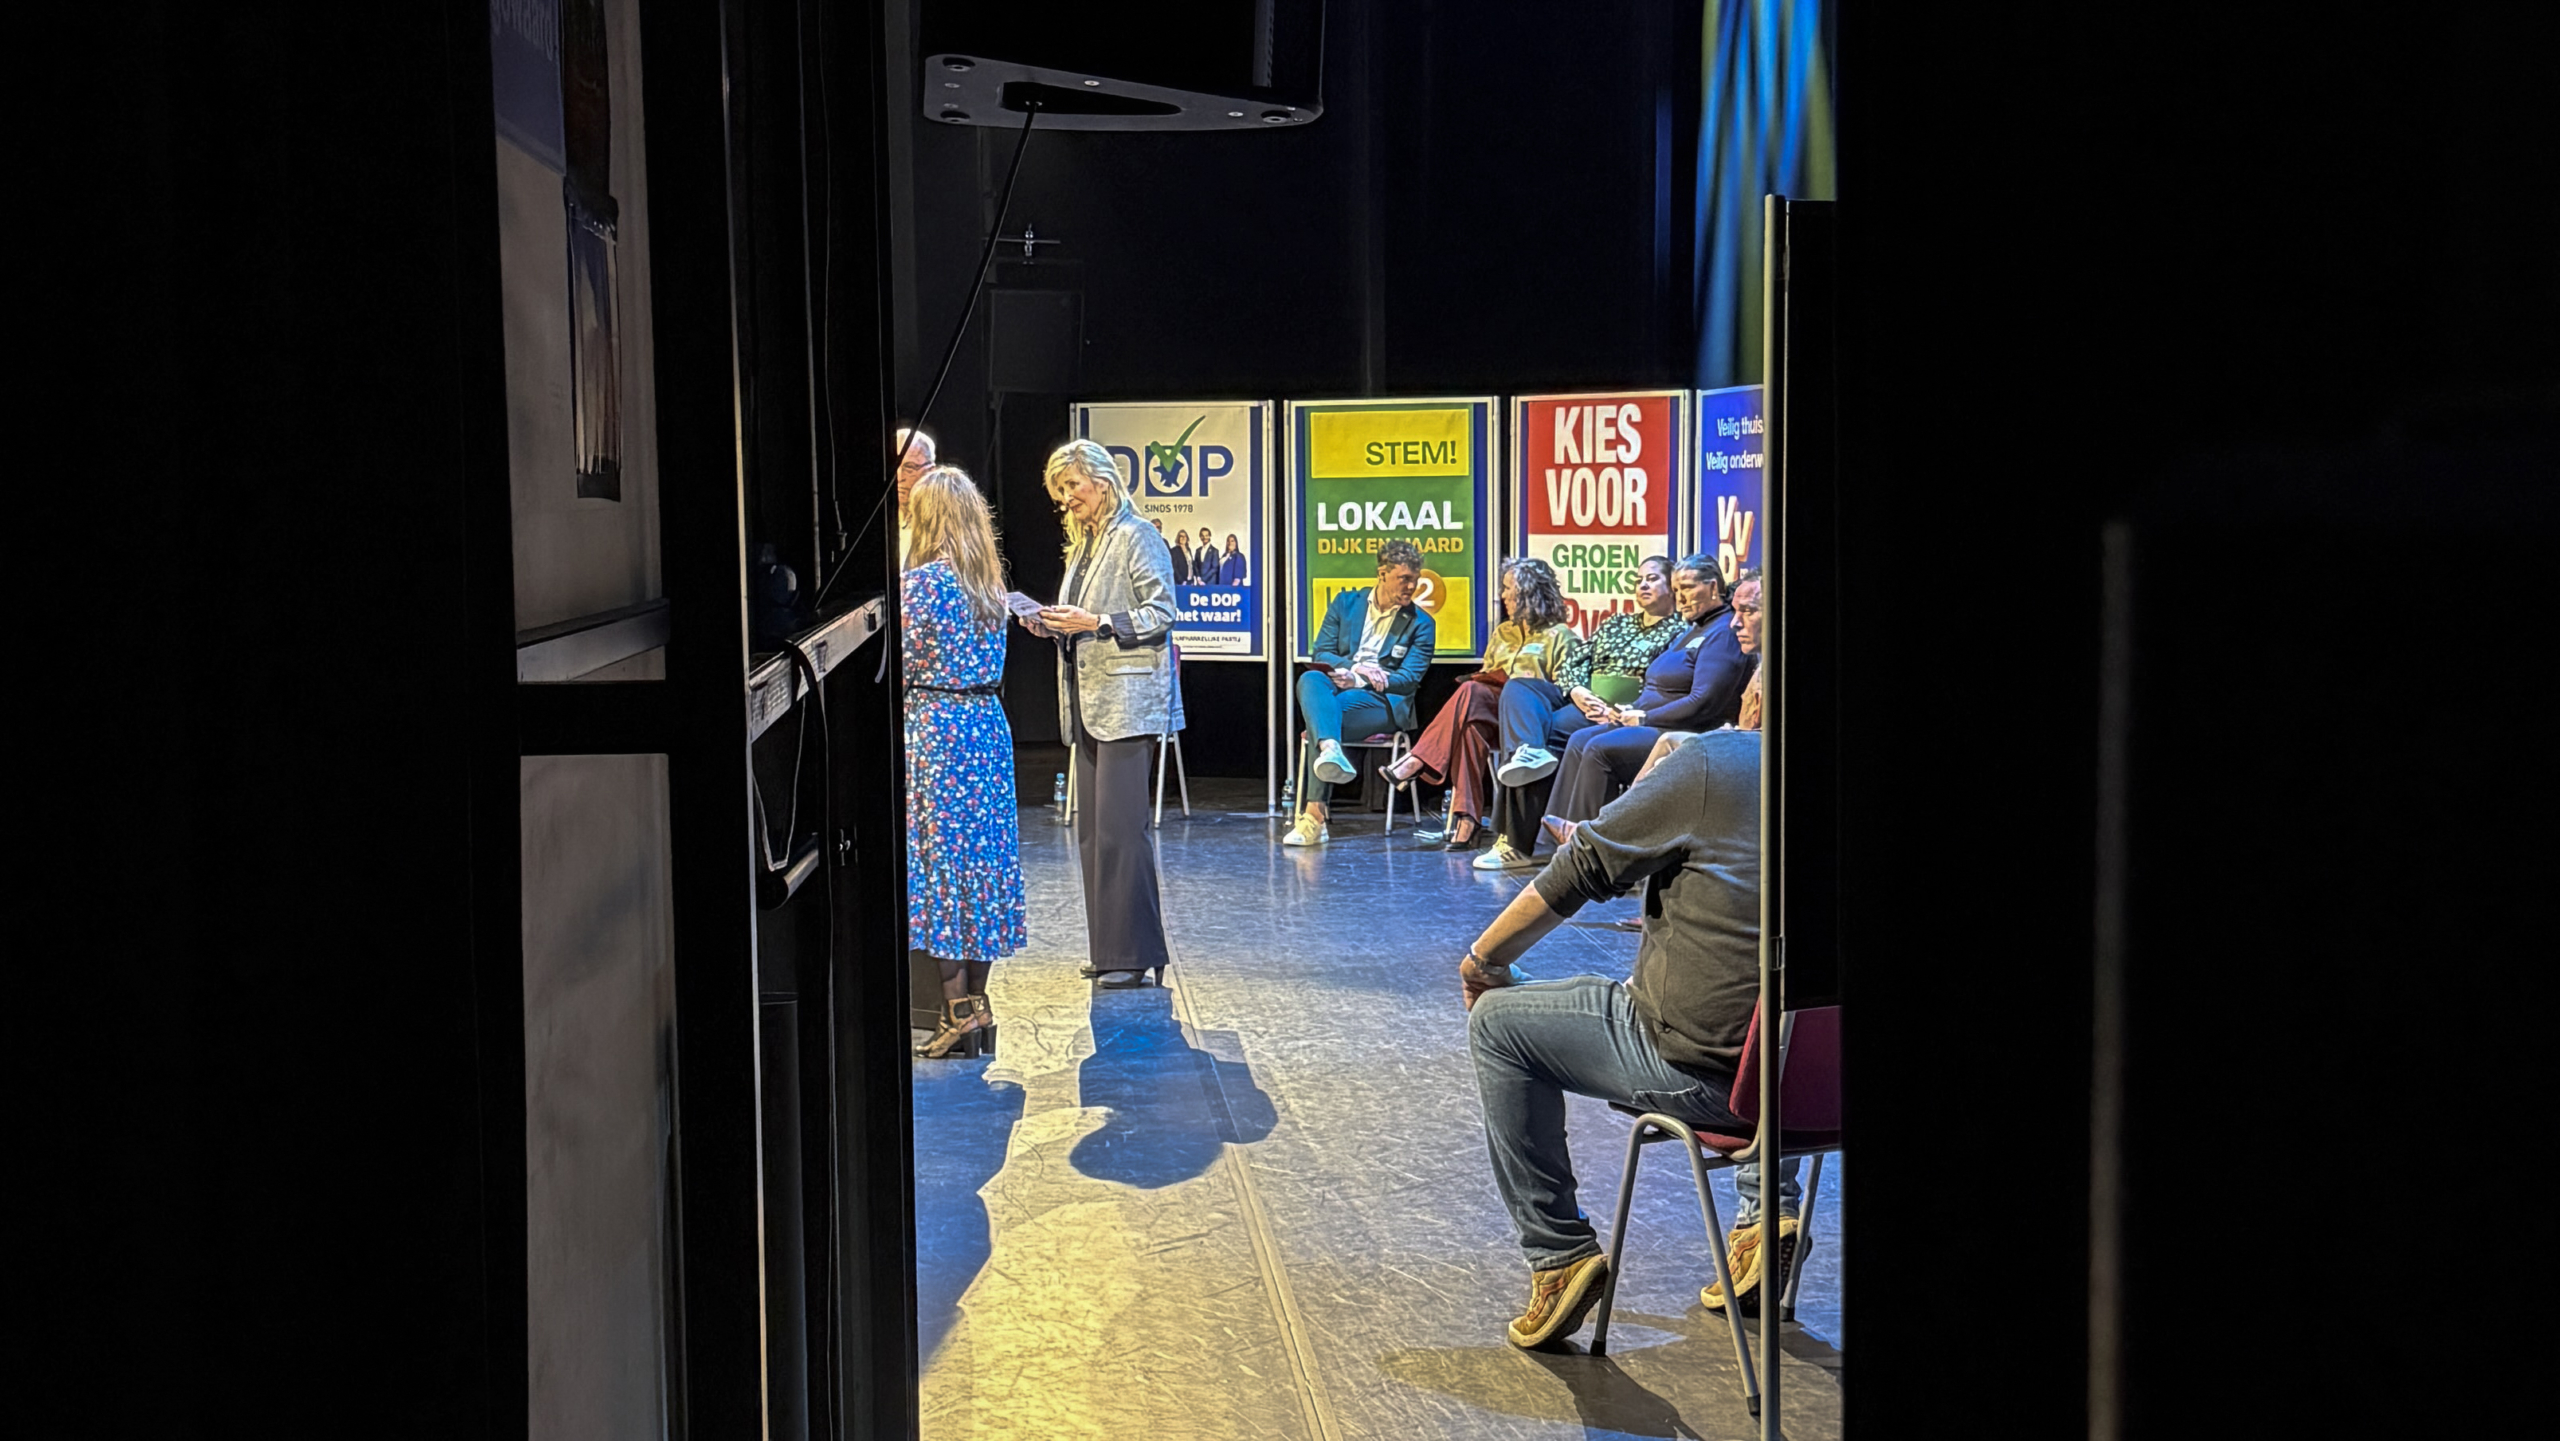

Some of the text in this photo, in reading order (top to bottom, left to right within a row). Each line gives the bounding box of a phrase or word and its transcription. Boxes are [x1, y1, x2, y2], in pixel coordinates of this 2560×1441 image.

[1554, 403, 1642, 465] KIES
[1717, 417, 1739, 441] Veilig
[1365, 440, 1457, 466] STEM!
[1706, 451, 1729, 475] Veilig
[1144, 504, 1193, 513] SINDS 1978
[1545, 467, 1648, 527] VOOR
[1317, 501, 1464, 532] LOKAAL
[1317, 538, 1362, 554] DIJK
[1395, 537, 1464, 554] AARD
[1552, 544, 1639, 568] GROEN
[1414, 577, 1435, 607] 2
[1567, 570, 1637, 594] LINKS
[1190, 593, 1241, 607] De DOP
[1175, 608, 1241, 622] het waar!
